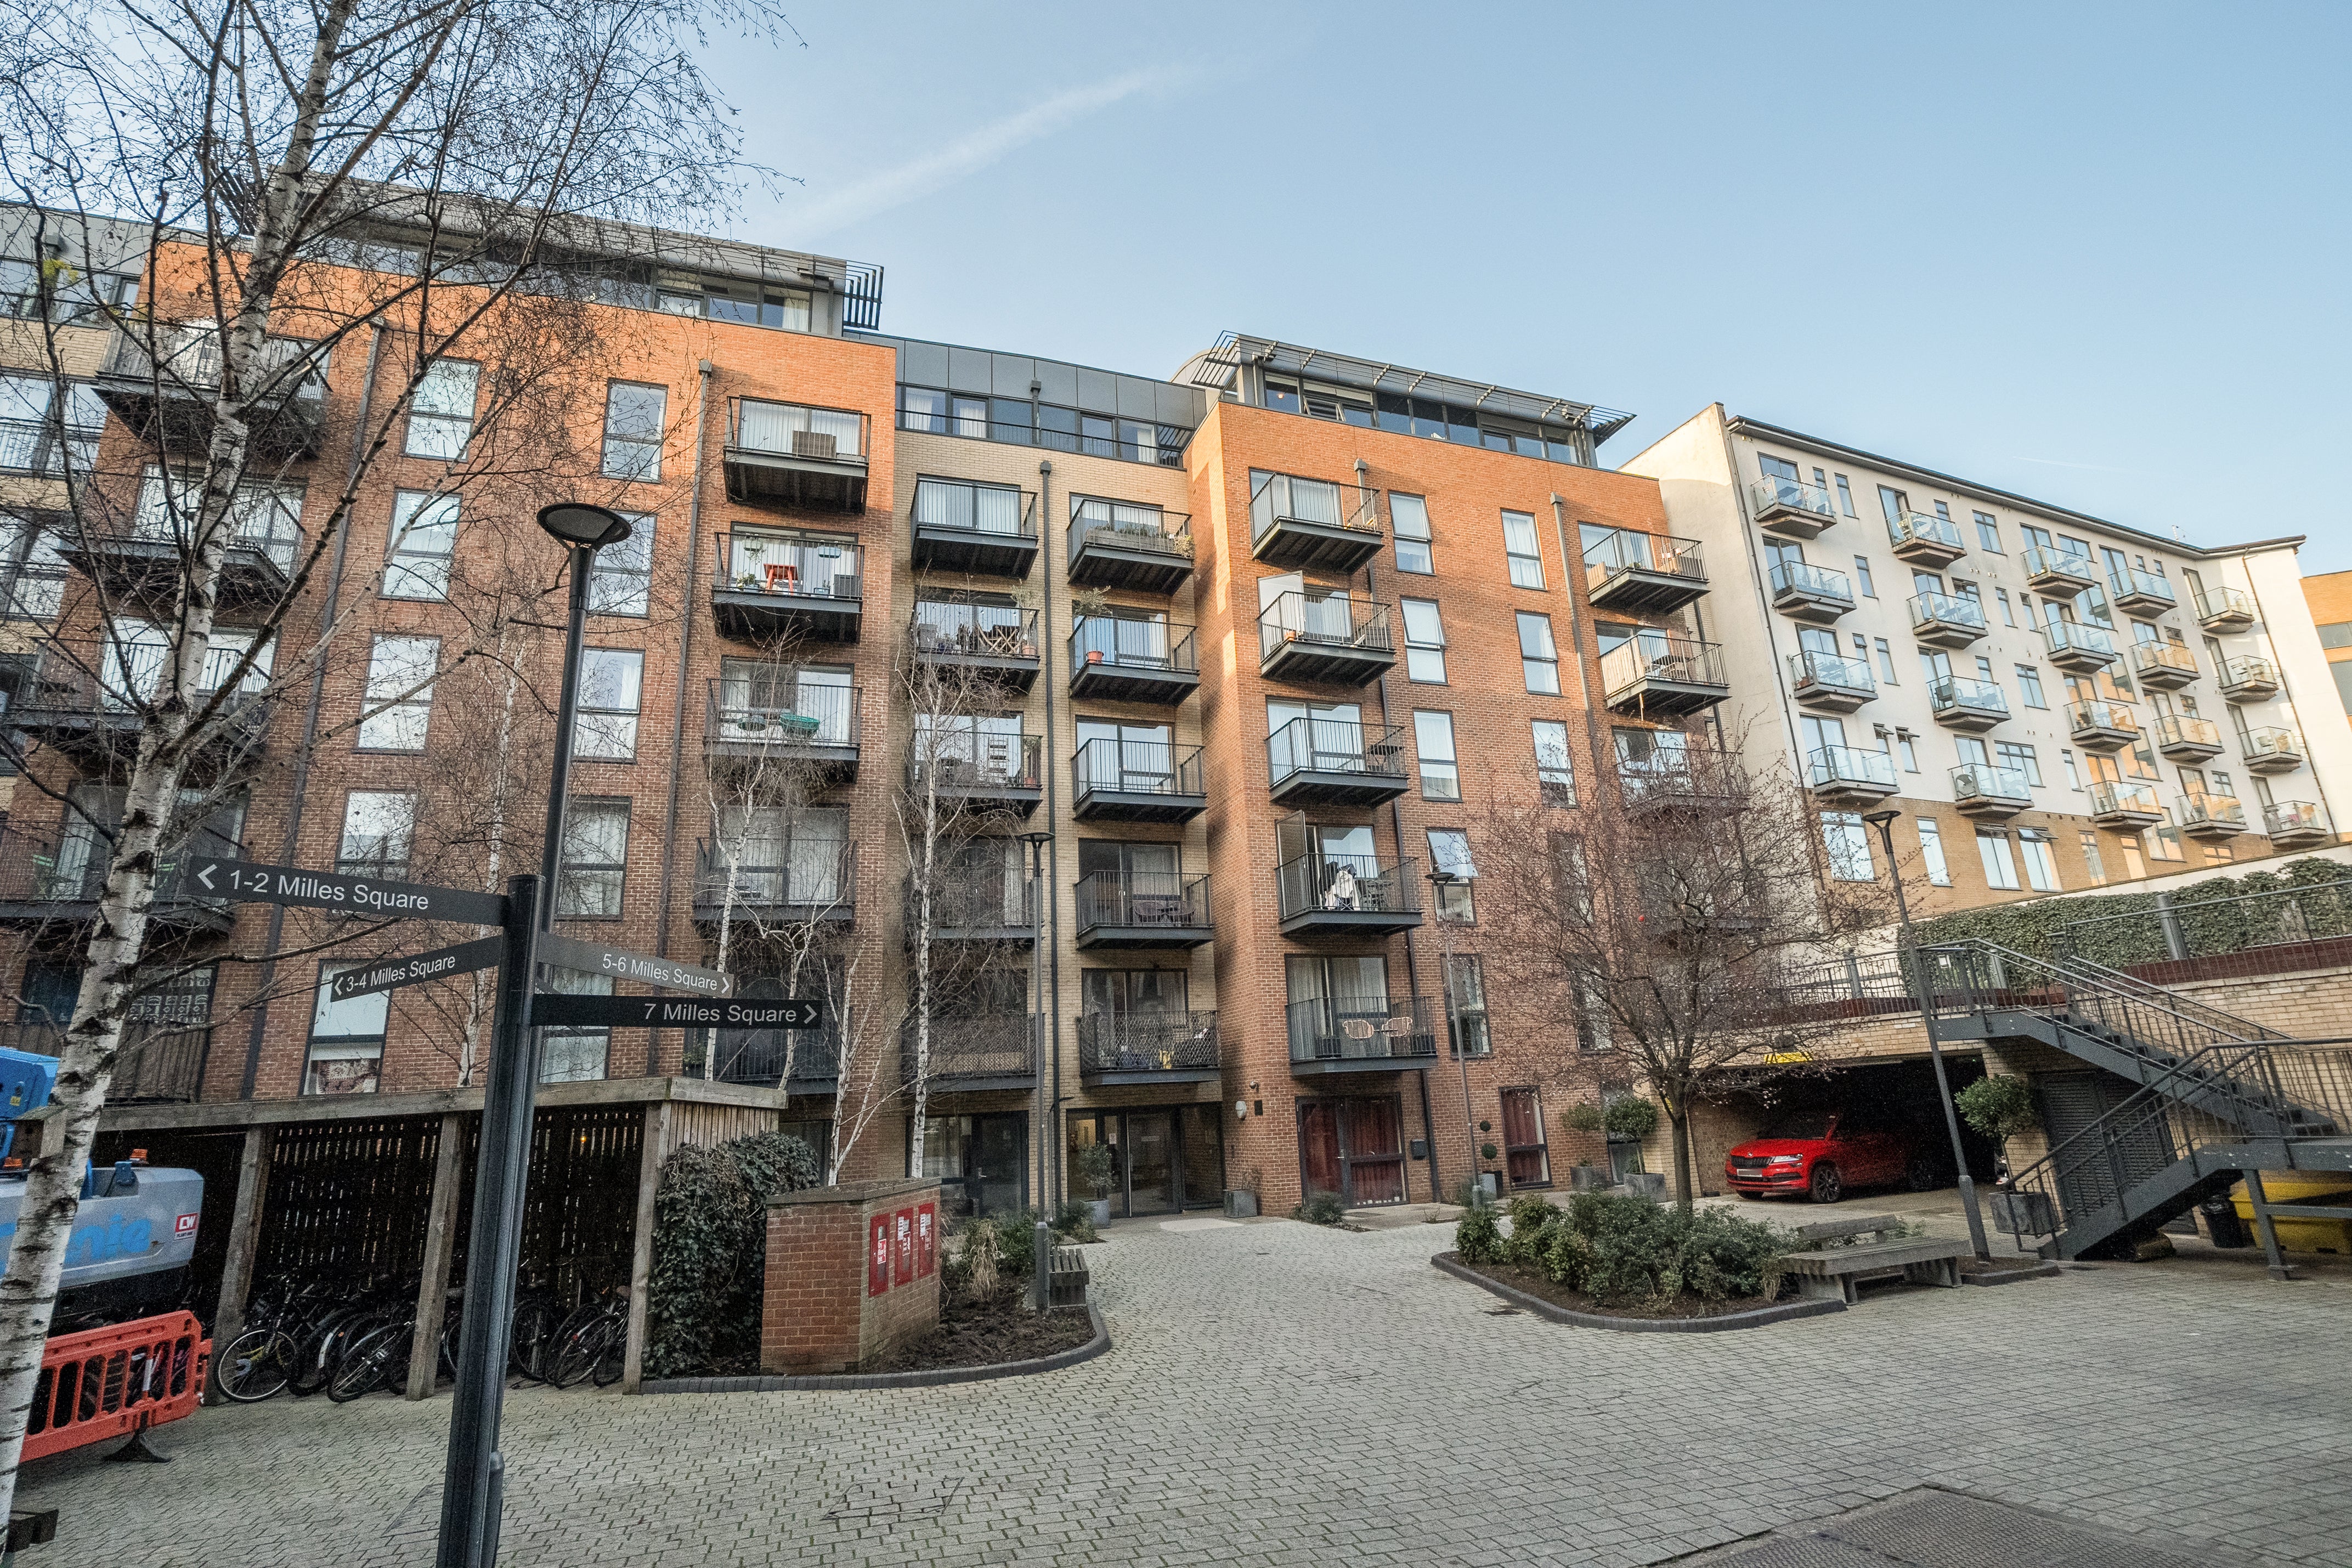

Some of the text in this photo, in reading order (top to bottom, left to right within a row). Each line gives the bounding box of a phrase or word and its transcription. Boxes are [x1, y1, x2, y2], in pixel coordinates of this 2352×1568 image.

[230, 870, 429, 910] 1-2 Milles Square
[346, 956, 455, 992] 3-4 Milles Square
[602, 953, 717, 990] 5-6 Milles Square
[644, 1003, 797, 1026] 7 Milles Square
[179, 1215, 196, 1230] CW
